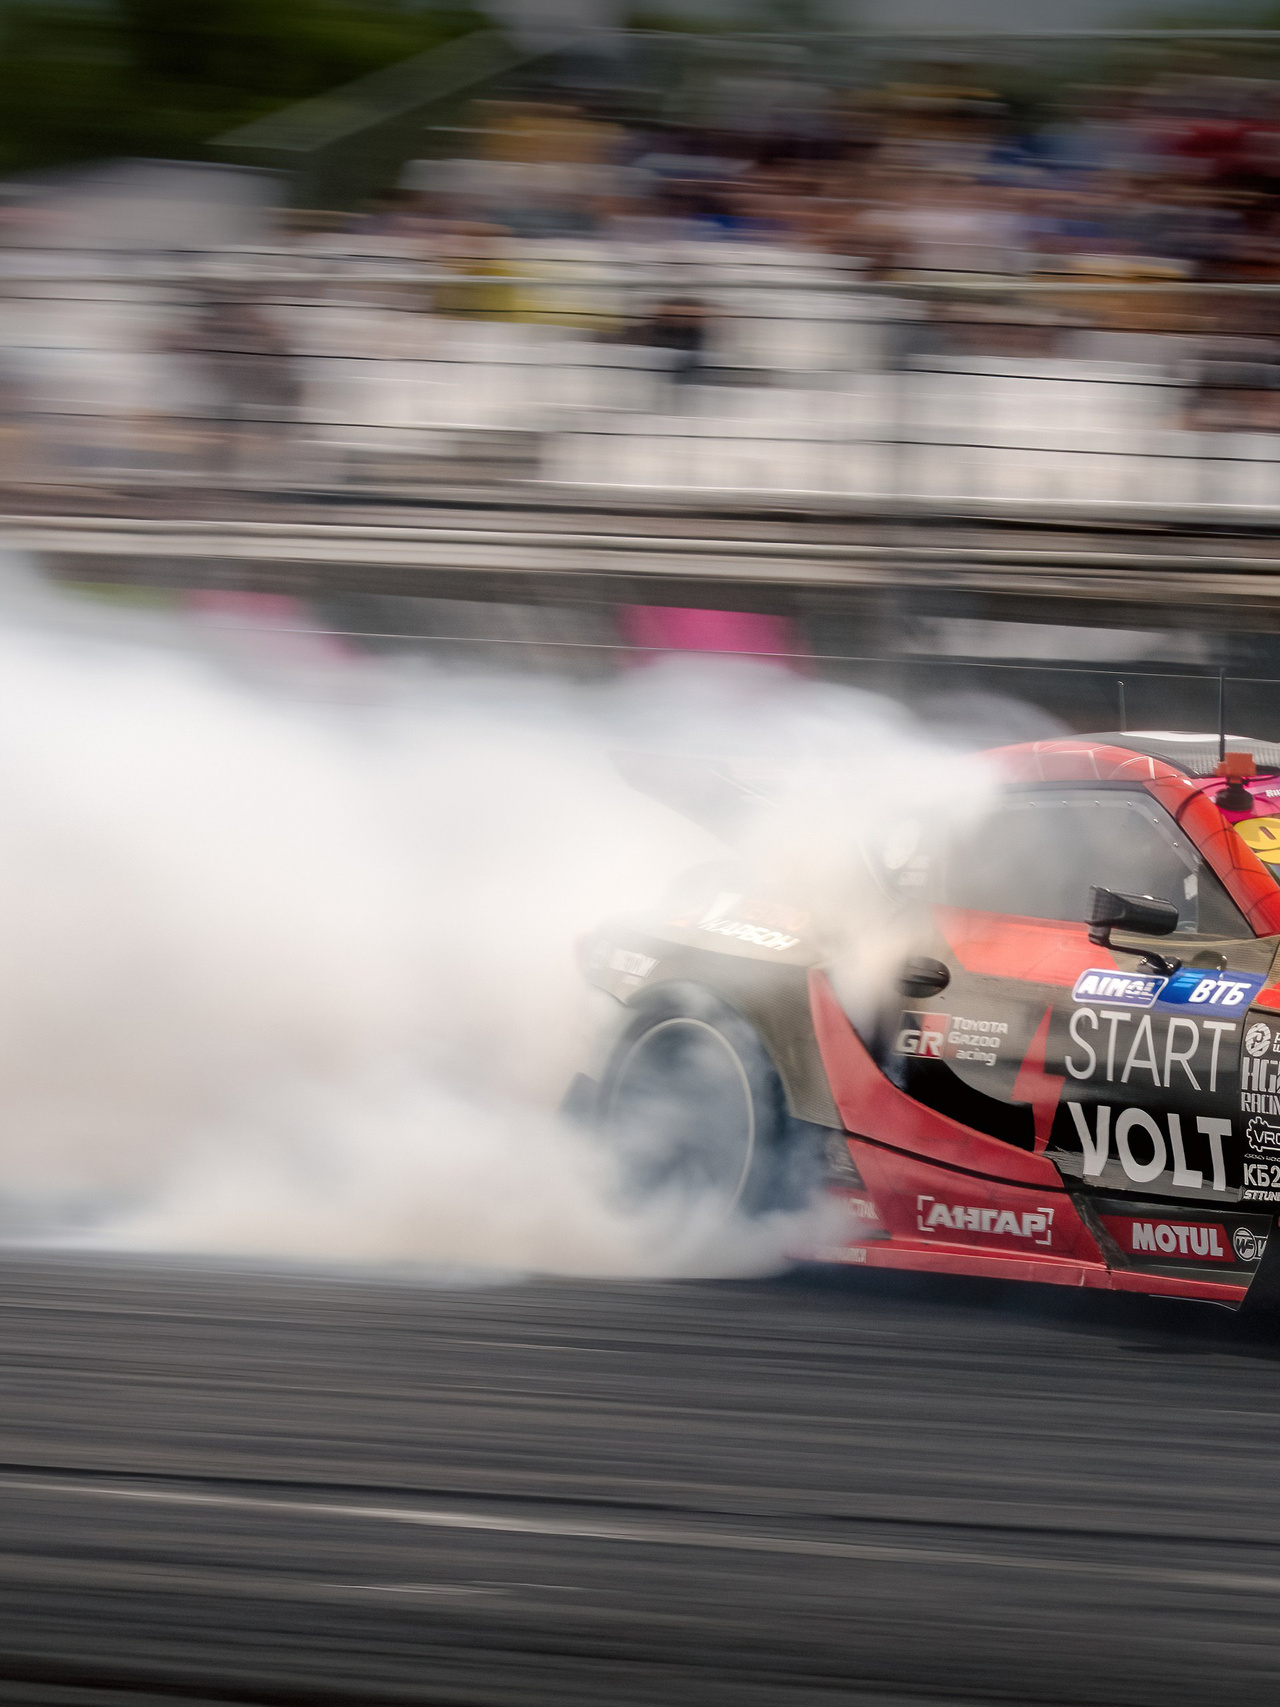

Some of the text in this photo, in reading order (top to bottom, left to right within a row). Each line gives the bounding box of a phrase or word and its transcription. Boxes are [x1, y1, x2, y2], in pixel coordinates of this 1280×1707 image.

[1077, 975, 1156, 1000] AIMOL
[1189, 979, 1251, 1005] ВТБ
[952, 1016, 1009, 1034] TOYOTA
[896, 1029, 944, 1056] GR
[948, 1031, 1001, 1048] GAZOO
[1064, 1007, 1236, 1092] START
[1066, 1101, 1233, 1192] VOLT
[925, 1203, 1048, 1238] АНГАР
[1132, 1222, 1223, 1257] MOTUL
